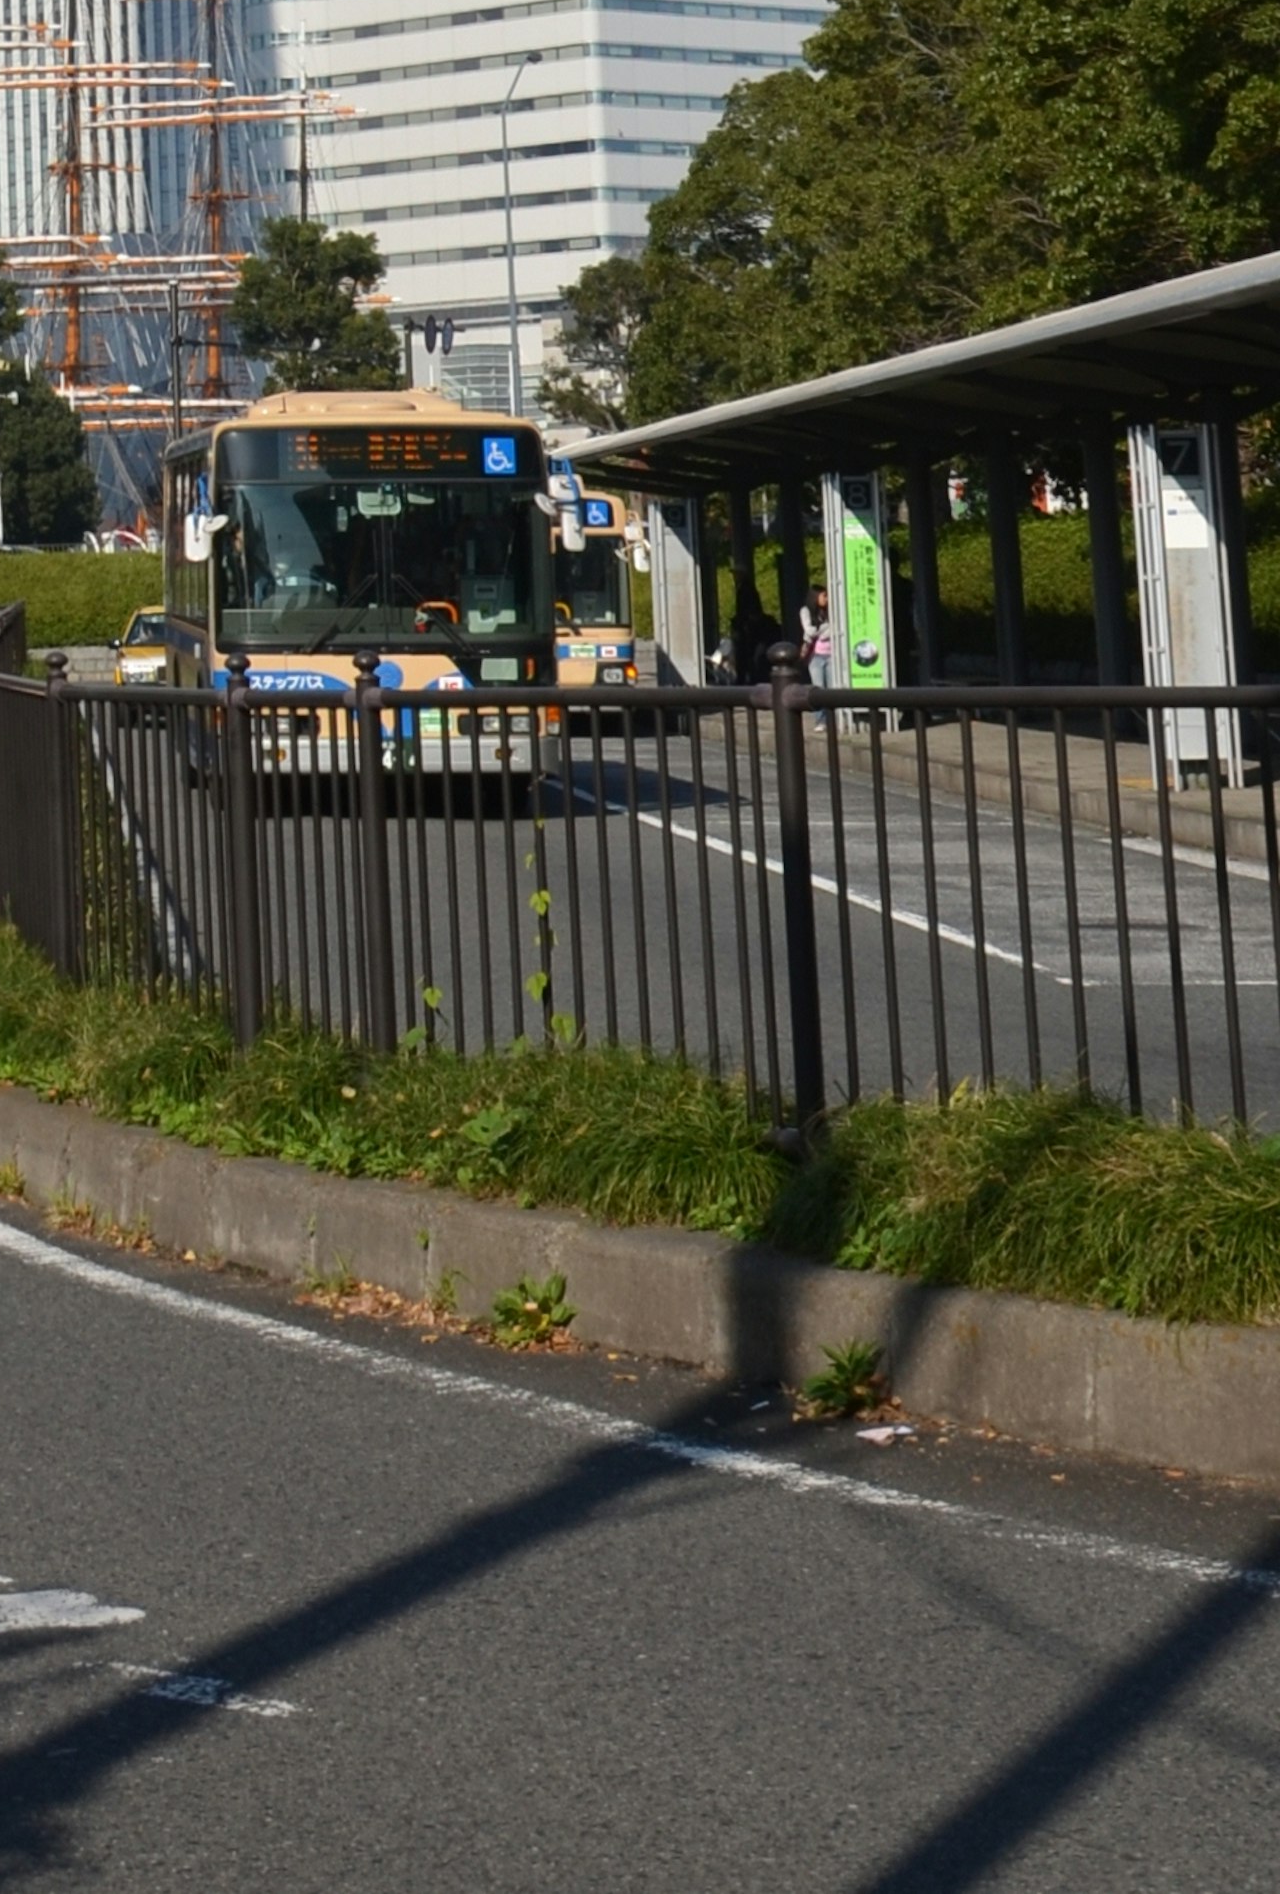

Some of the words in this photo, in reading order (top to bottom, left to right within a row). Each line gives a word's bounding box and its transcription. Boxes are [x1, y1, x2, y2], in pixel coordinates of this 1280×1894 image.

[1165, 440, 1190, 471] 7
[848, 483, 867, 508] 8
[250, 675, 324, 690] ステップバス
